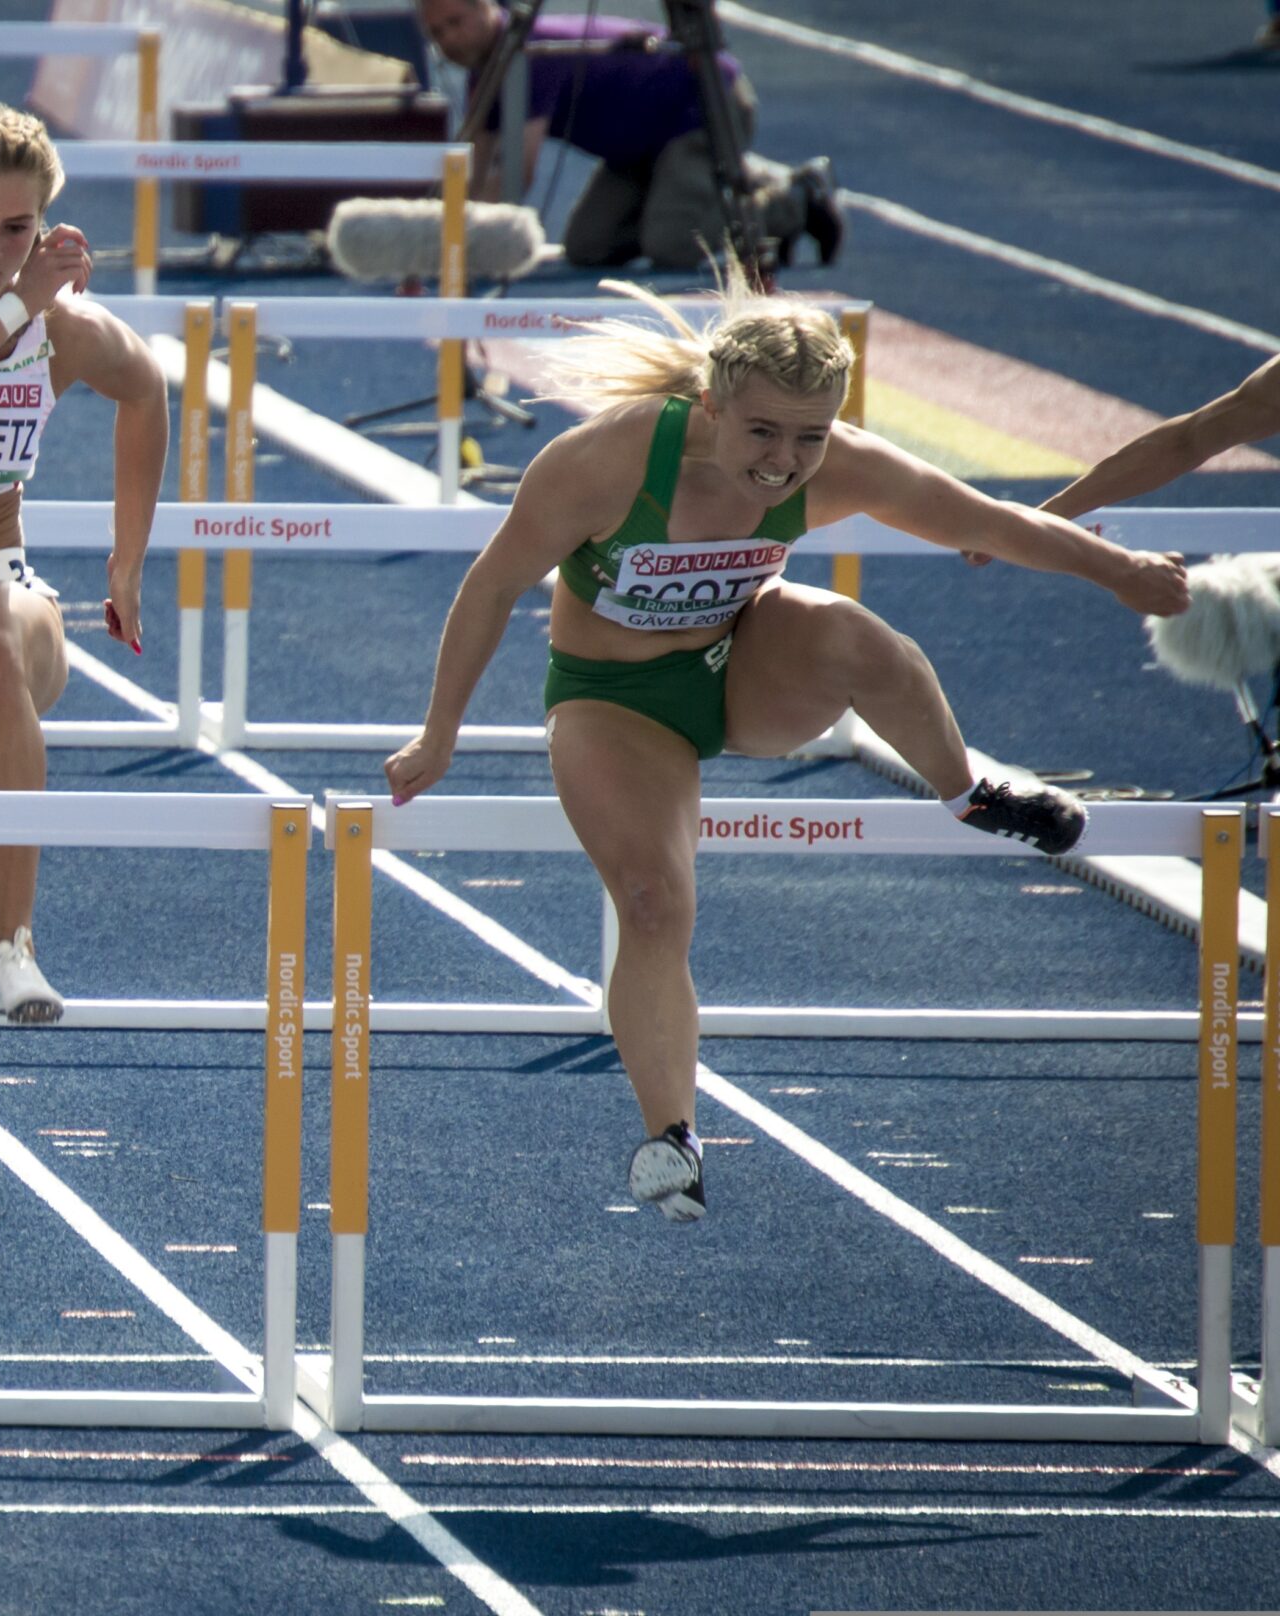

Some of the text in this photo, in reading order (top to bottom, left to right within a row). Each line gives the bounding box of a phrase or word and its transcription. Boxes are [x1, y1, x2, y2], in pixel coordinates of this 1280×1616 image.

[271, 518, 332, 541] Sport
[656, 545, 785, 573] BAUHAUS
[628, 613, 690, 627] GÄVLE
[789, 817, 864, 845] Sport
[274, 1023, 296, 1079] Sport
[341, 1023, 362, 1079] Sport
[1207, 1033, 1231, 1089] Sport
